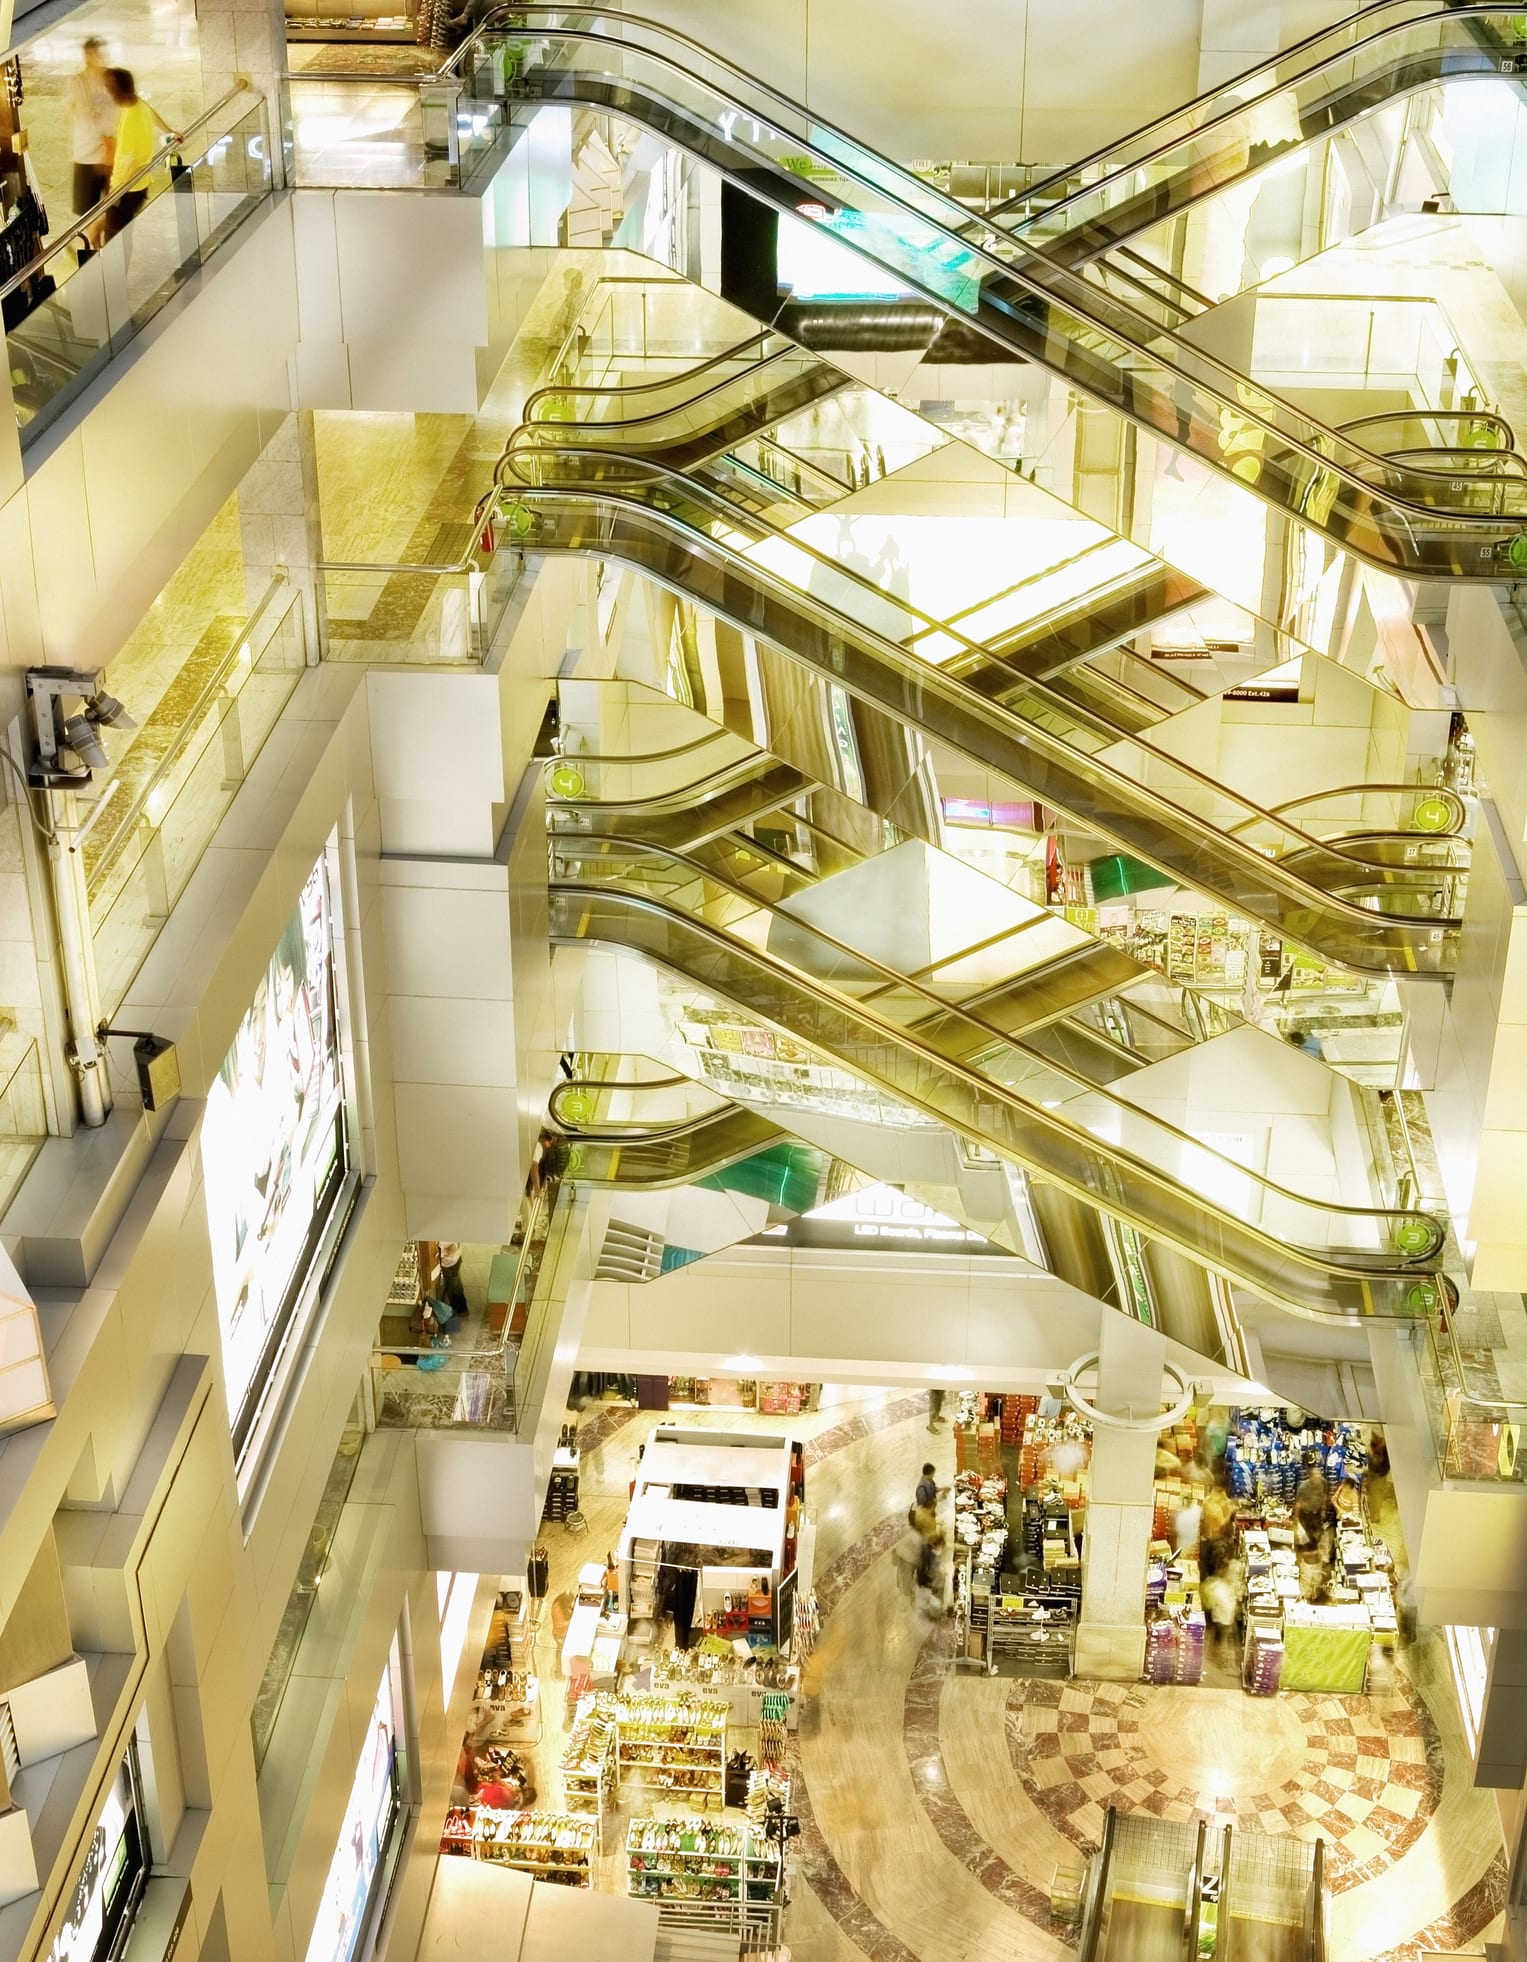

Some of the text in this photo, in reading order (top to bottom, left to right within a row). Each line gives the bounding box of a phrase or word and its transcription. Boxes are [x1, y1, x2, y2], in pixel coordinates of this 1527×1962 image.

[785, 157, 808, 170] We
[653, 1681, 670, 1689] eva
[702, 1686, 719, 1694] eva
